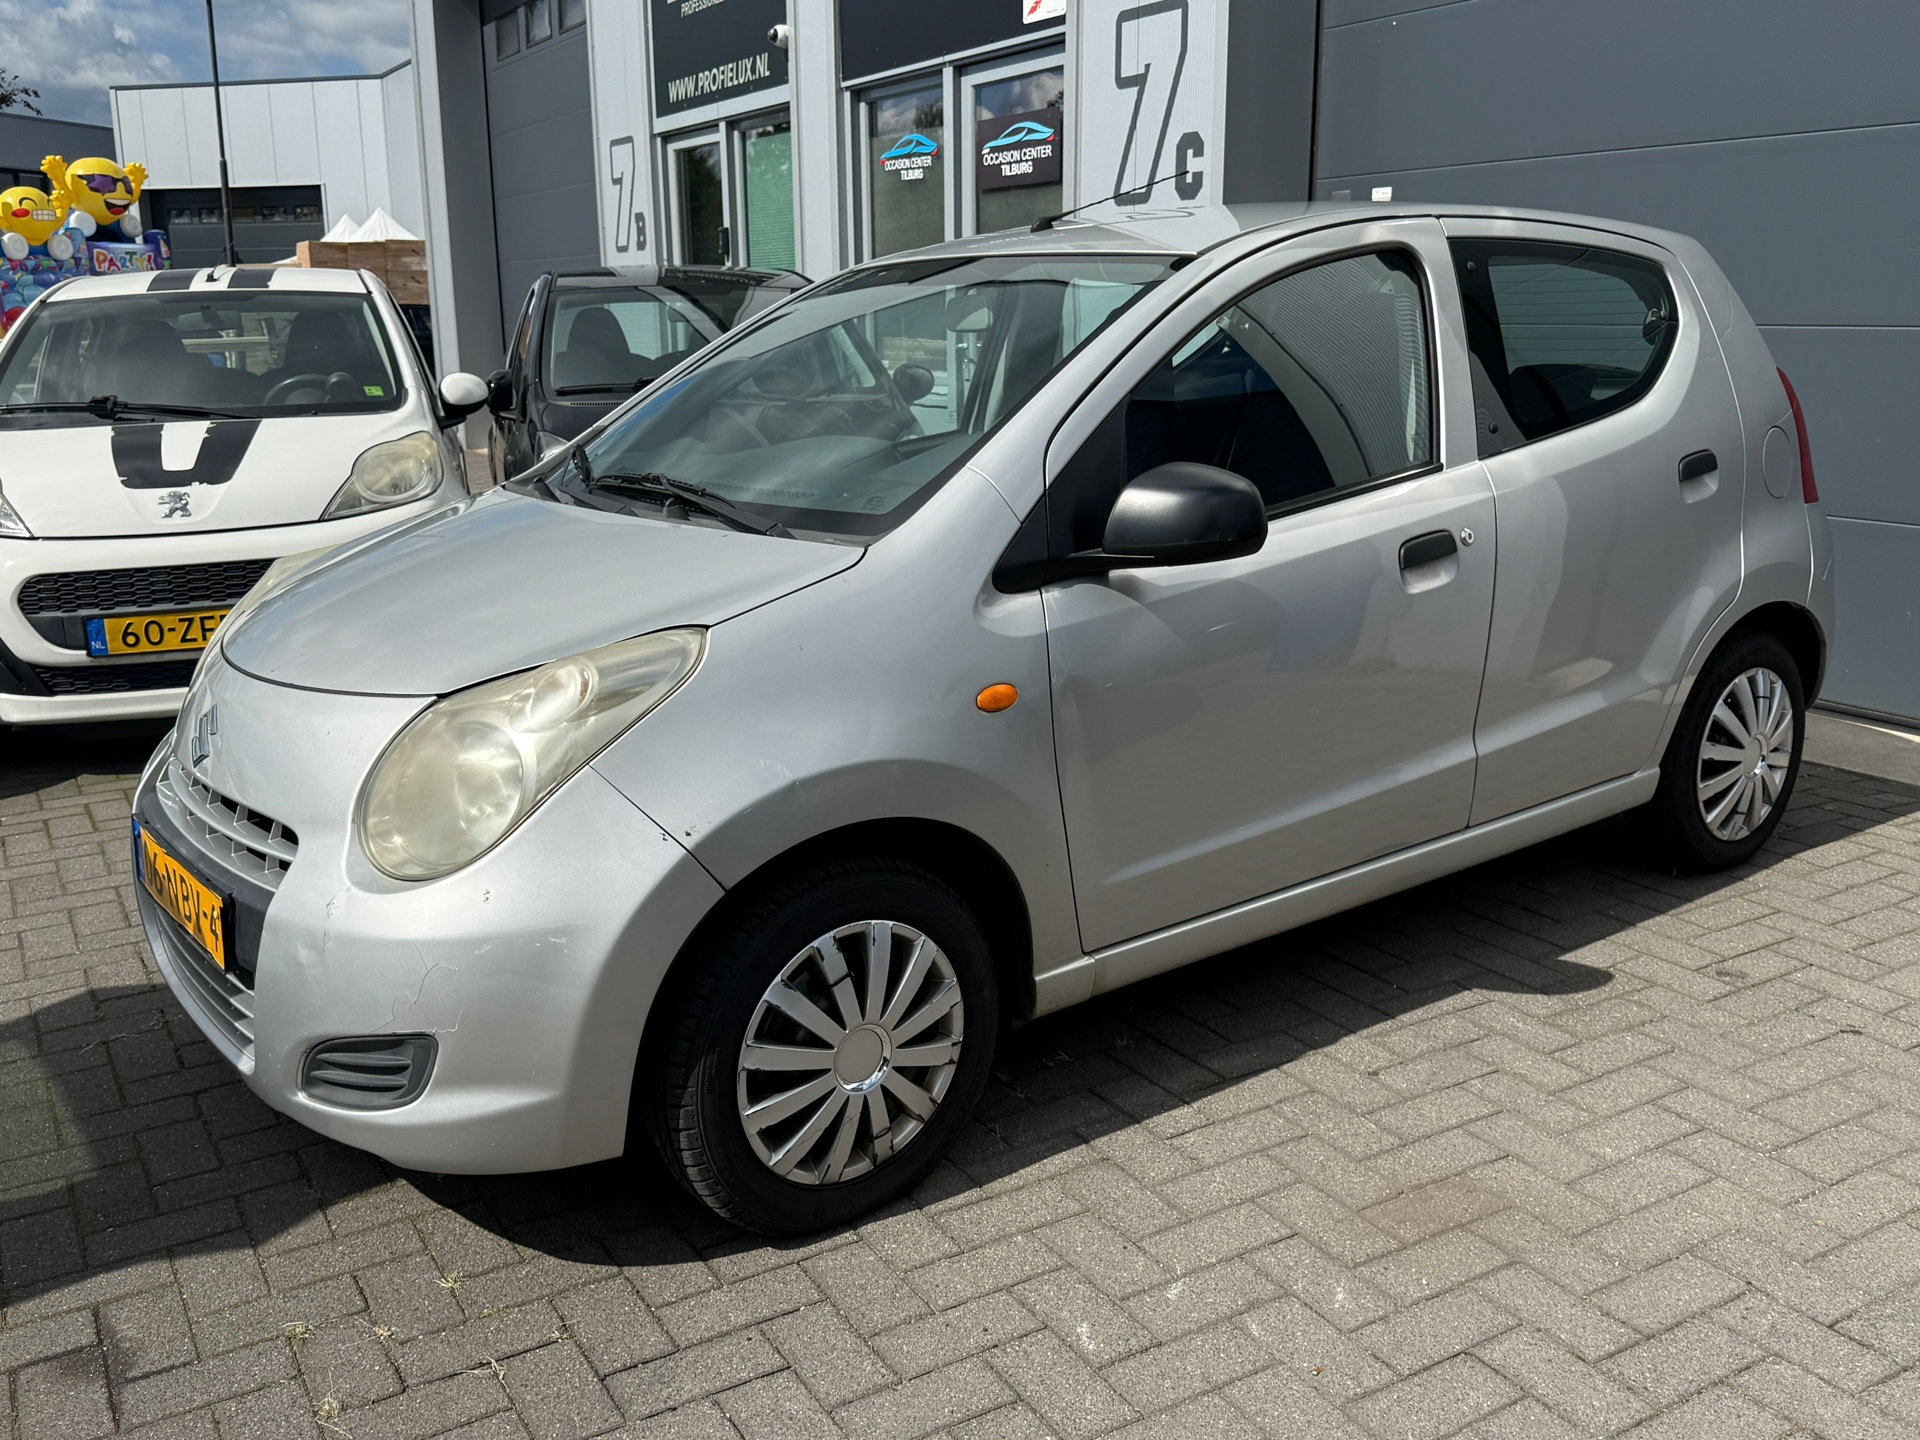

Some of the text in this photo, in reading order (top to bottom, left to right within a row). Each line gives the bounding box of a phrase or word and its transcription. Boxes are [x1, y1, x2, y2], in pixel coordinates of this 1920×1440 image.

[668, 52, 771, 104] WWW.PROFIELUX.NL
[884, 155, 932, 171] OCCASION CENTER
[983, 144, 1053, 166] OCCASION CENTER
[900, 168, 924, 181] TILBURG
[1001, 161, 1033, 177] TILBURG
[93, 248, 157, 273] PARTY!
[120, 613, 229, 648] 60-ZF
[91, 641, 106, 650] NL
